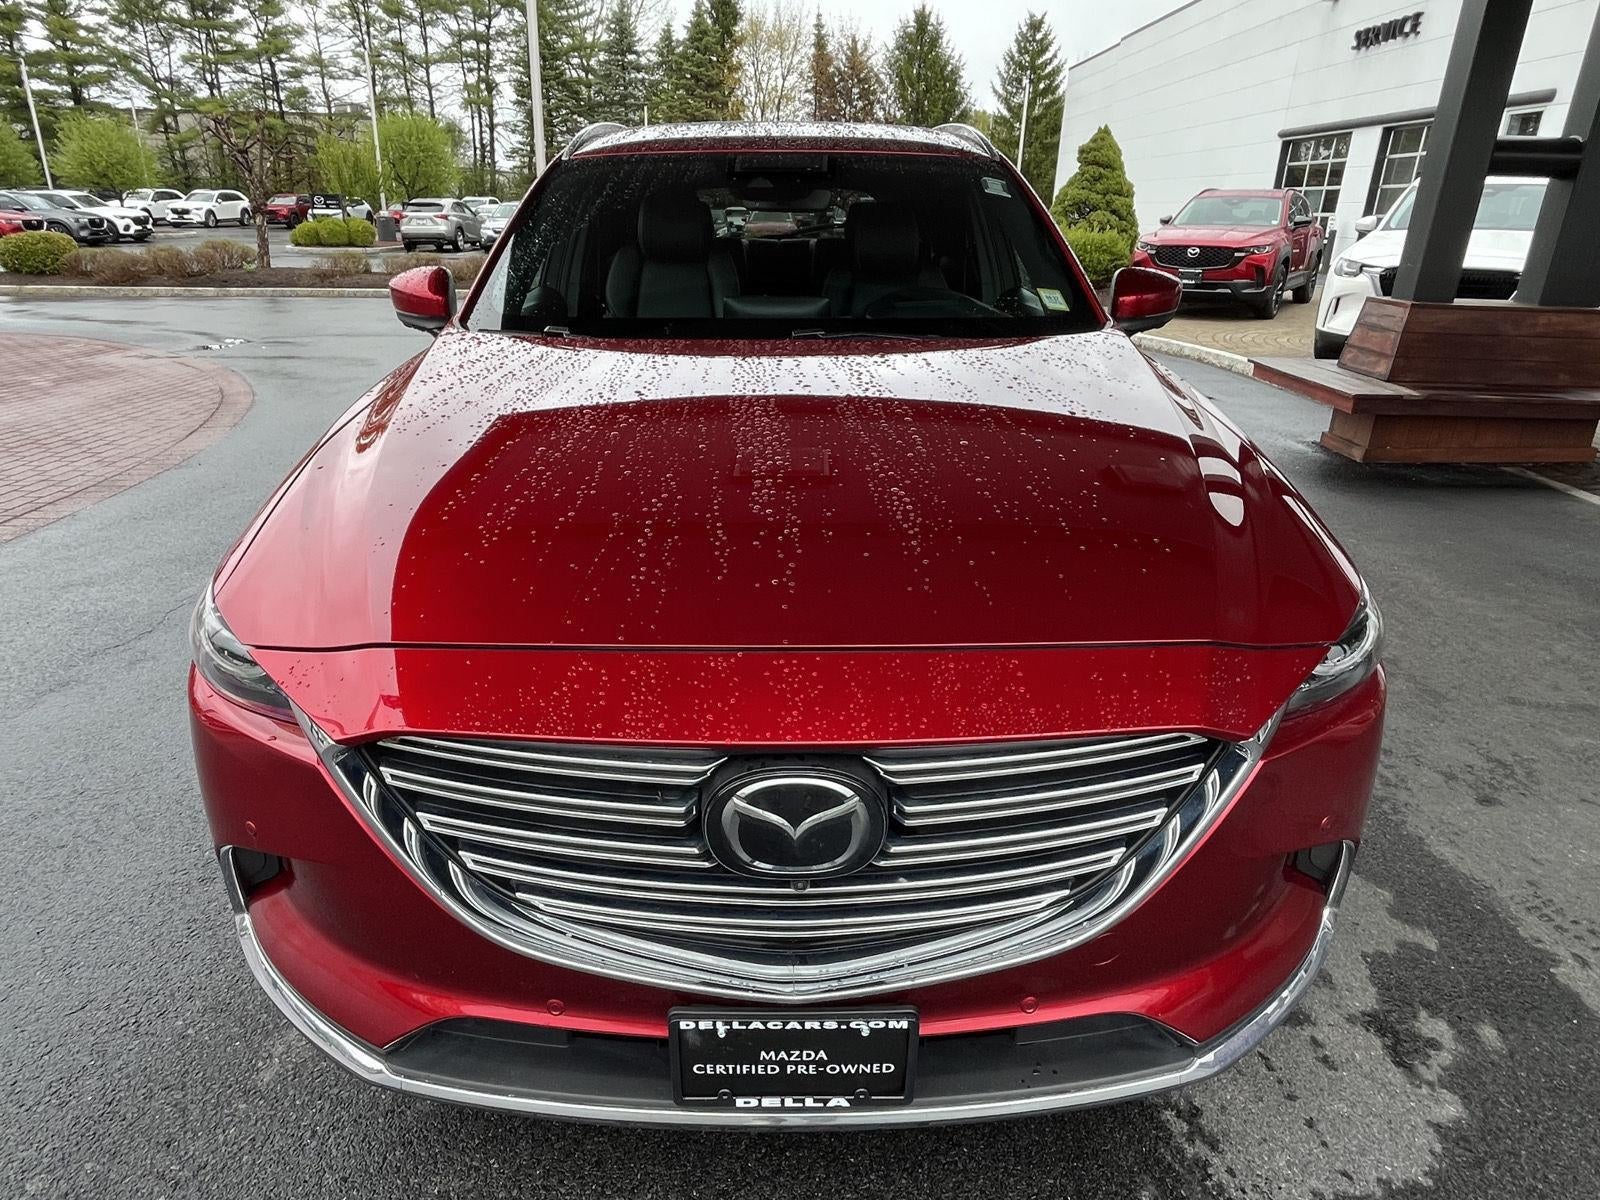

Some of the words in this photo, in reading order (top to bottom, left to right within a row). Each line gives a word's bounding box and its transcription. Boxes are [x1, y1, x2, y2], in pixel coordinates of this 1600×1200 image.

[1351, 11, 1424, 51] SERVICE
[679, 1020, 909, 1030] DELLACARS.COM
[760, 1050, 828, 1061] MAZDA
[692, 1064, 780, 1075] CERTIFIED
[787, 1063, 895, 1075] PRE-OWNED
[735, 1096, 851, 1108] DELLA
